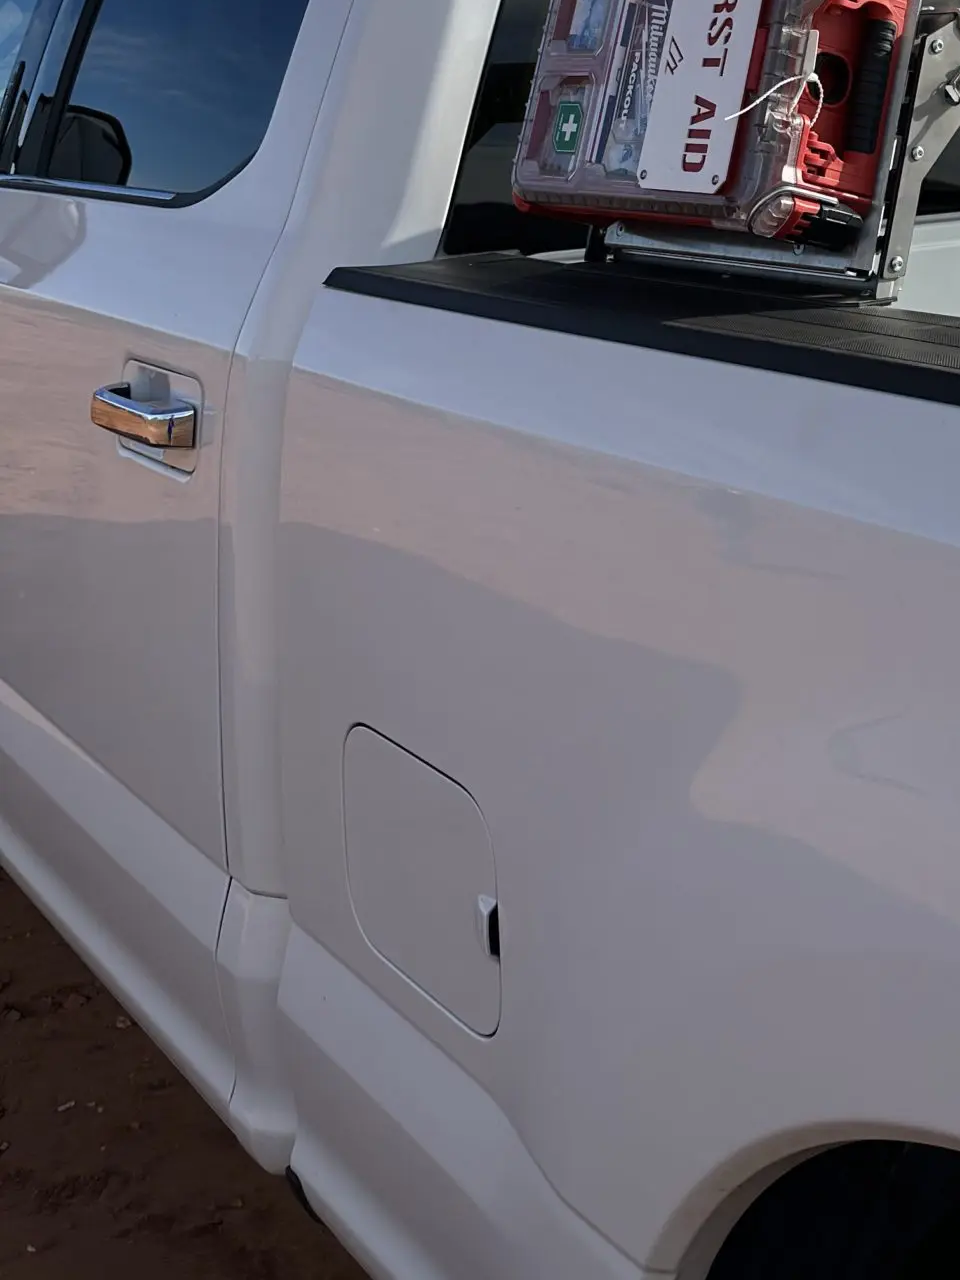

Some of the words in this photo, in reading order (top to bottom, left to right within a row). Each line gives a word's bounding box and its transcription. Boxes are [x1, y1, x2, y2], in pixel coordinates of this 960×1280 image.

[619, 51, 641, 130] PACKOUT
[645, 0, 669, 102] Milwaukee
[681, 95, 717, 173] AID
